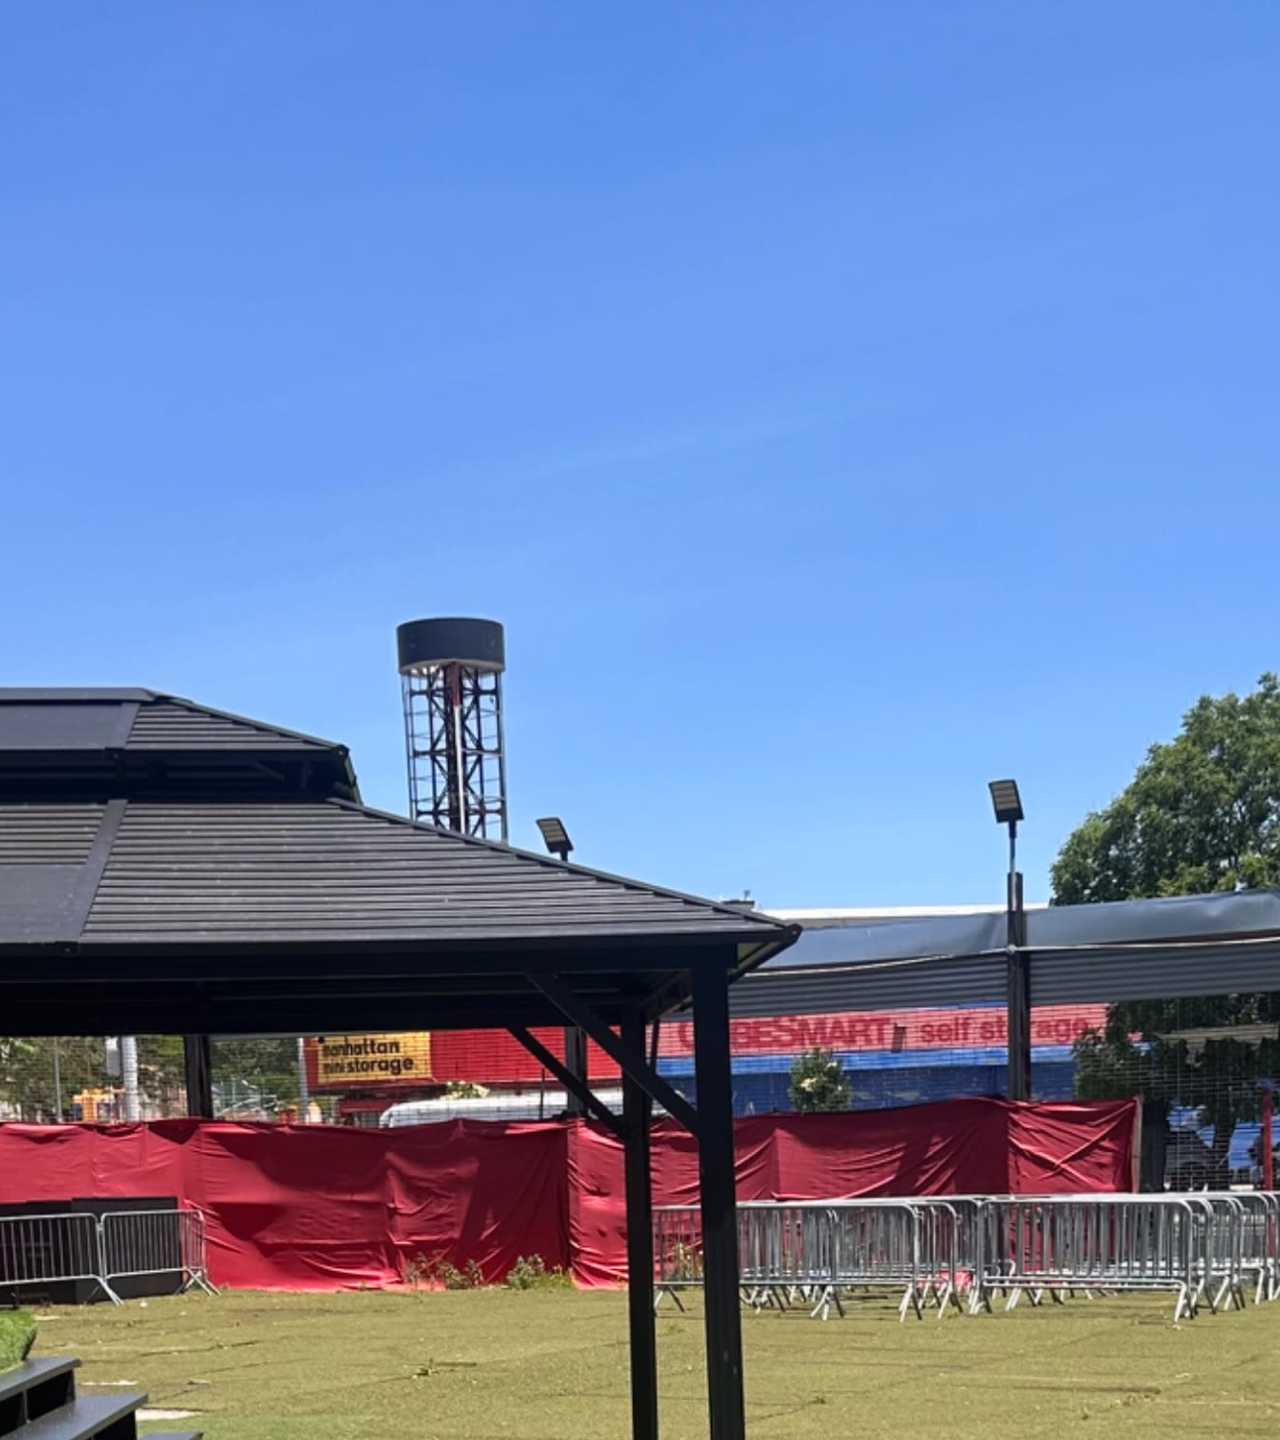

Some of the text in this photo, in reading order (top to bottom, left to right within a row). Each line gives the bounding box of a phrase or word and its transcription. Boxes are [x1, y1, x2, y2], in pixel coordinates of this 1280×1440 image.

[678, 1014, 1089, 1049] CBESMART self stage
[322, 1036, 400, 1056] manhattan
[348, 1057, 414, 1076] storage
